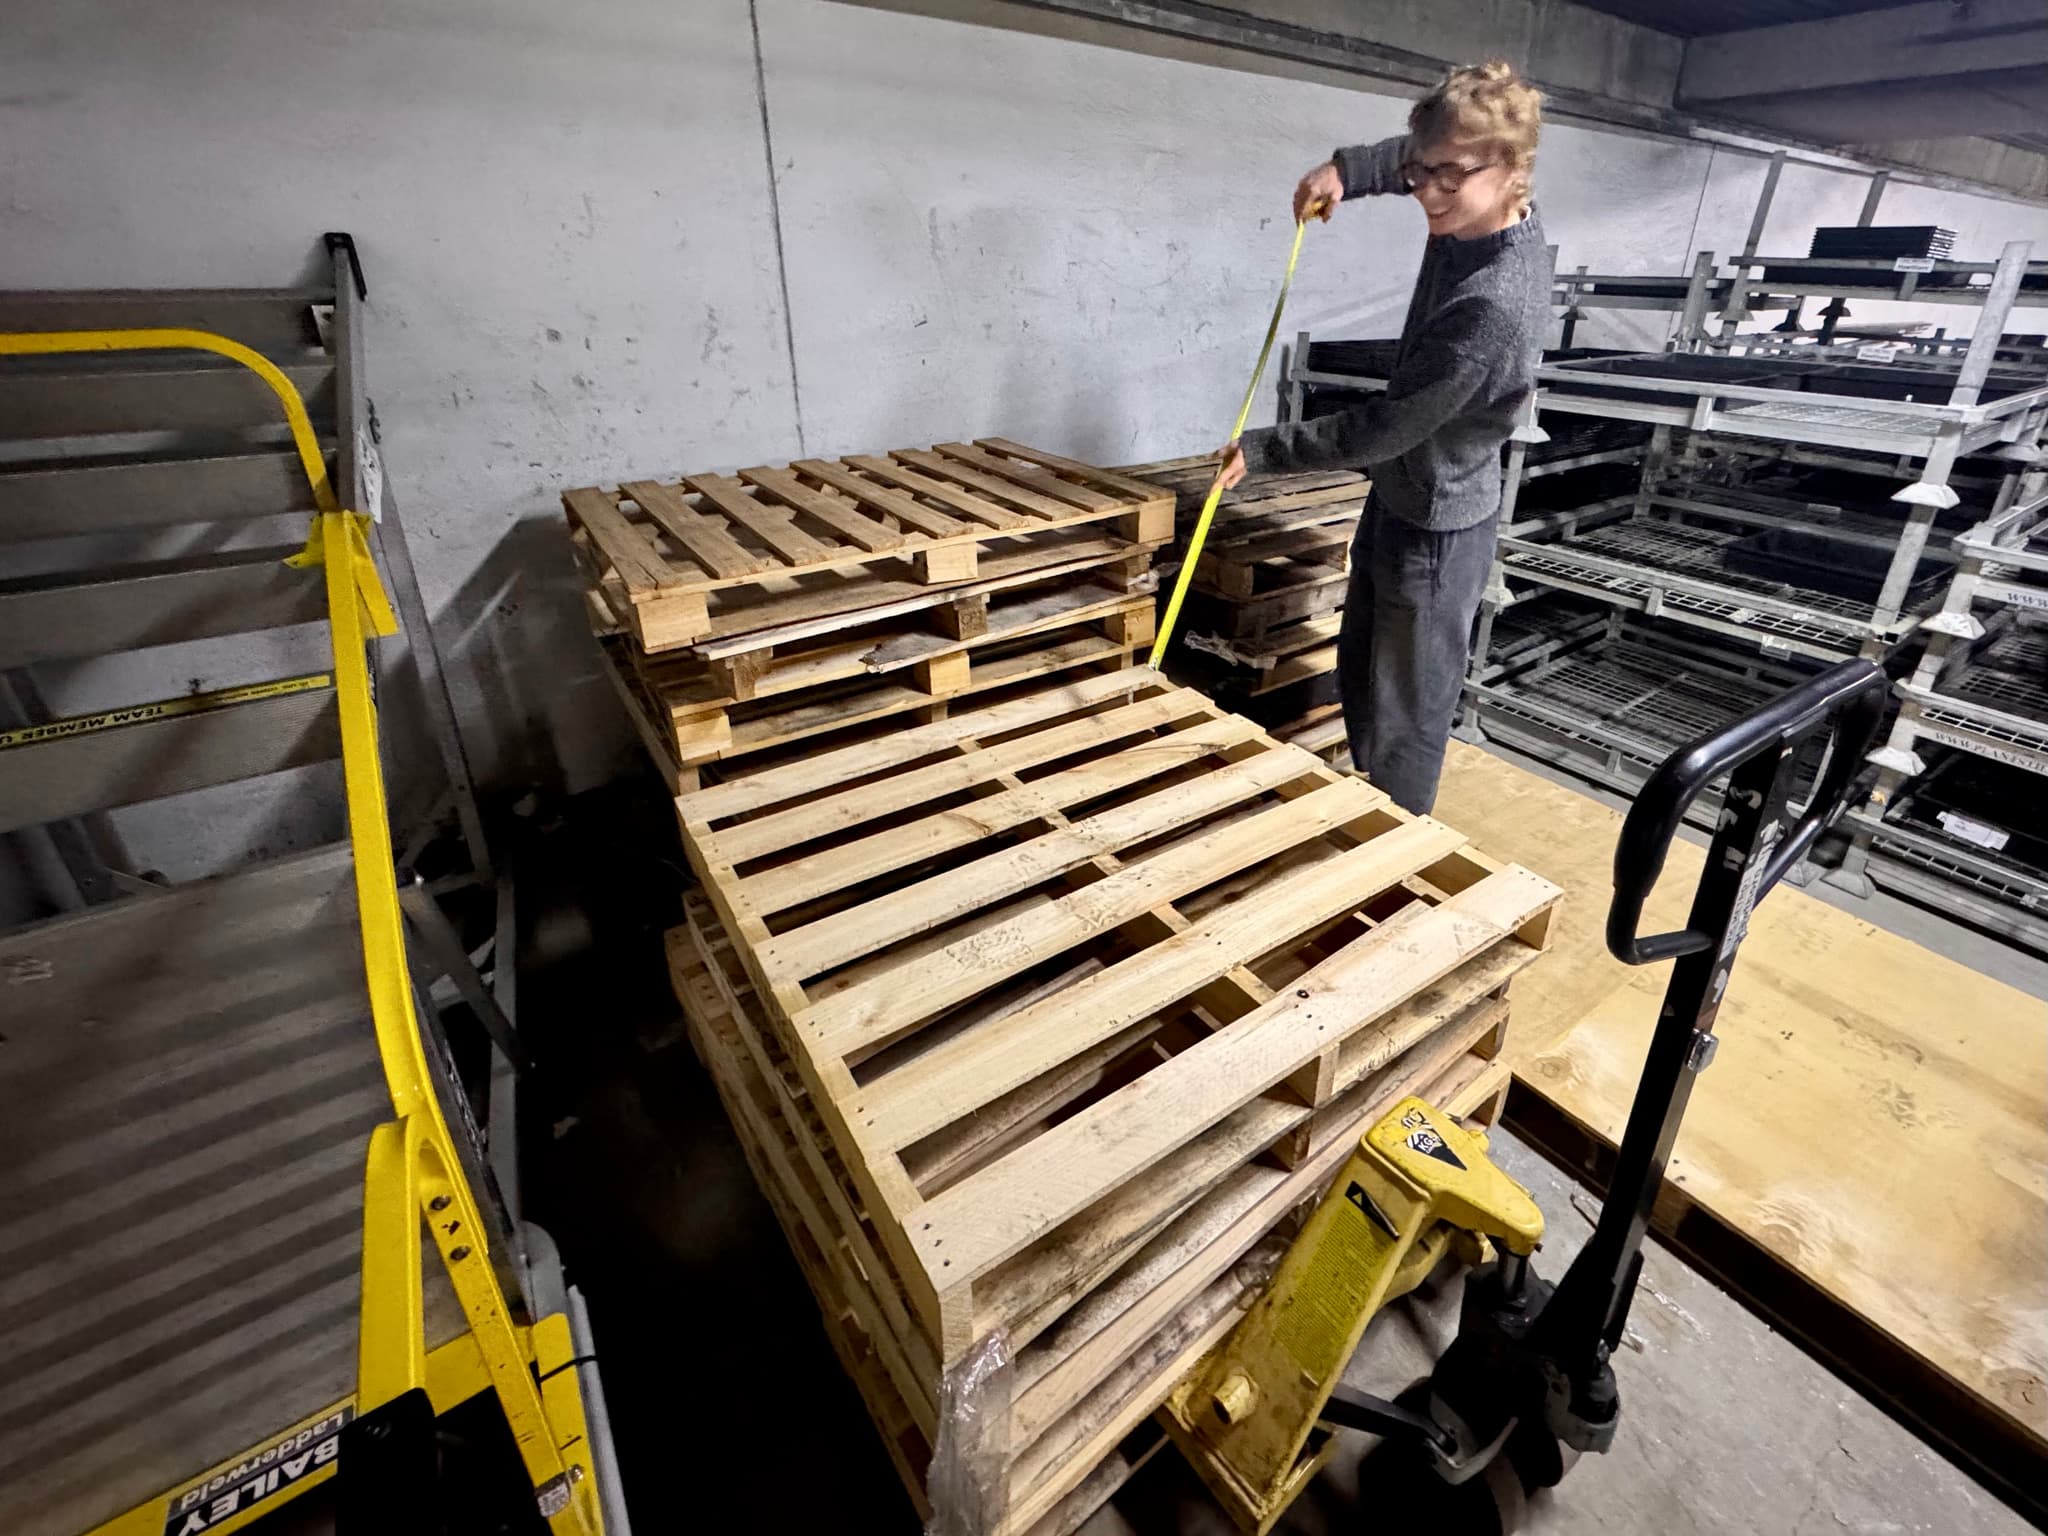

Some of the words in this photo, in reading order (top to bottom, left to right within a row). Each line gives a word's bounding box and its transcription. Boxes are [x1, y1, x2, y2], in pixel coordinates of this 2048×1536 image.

[22, 716, 107, 739] MEMBER
[112, 706, 163, 722] TEAM
[177, 1434, 340, 1536] BAILEY
[180, 1411, 344, 1510] Ladderweld
